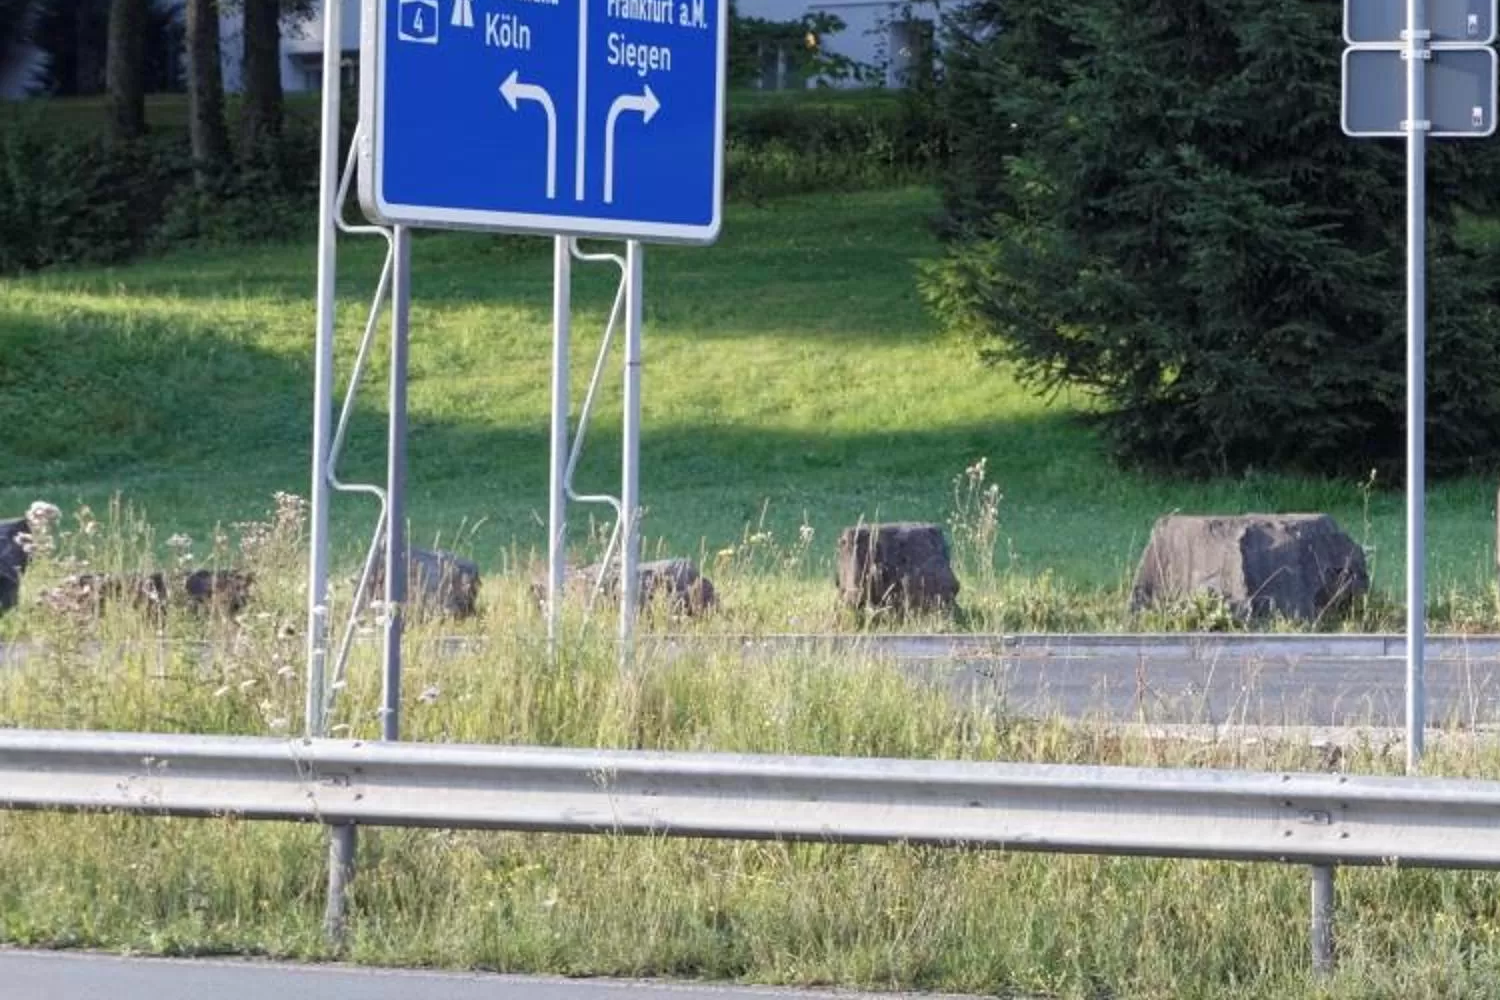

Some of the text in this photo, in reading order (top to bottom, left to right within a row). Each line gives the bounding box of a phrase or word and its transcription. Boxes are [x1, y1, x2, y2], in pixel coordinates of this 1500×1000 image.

[413, 6, 424, 34] 4
[485, 11, 531, 50] Köln
[607, 31, 671, 77] Siegen
